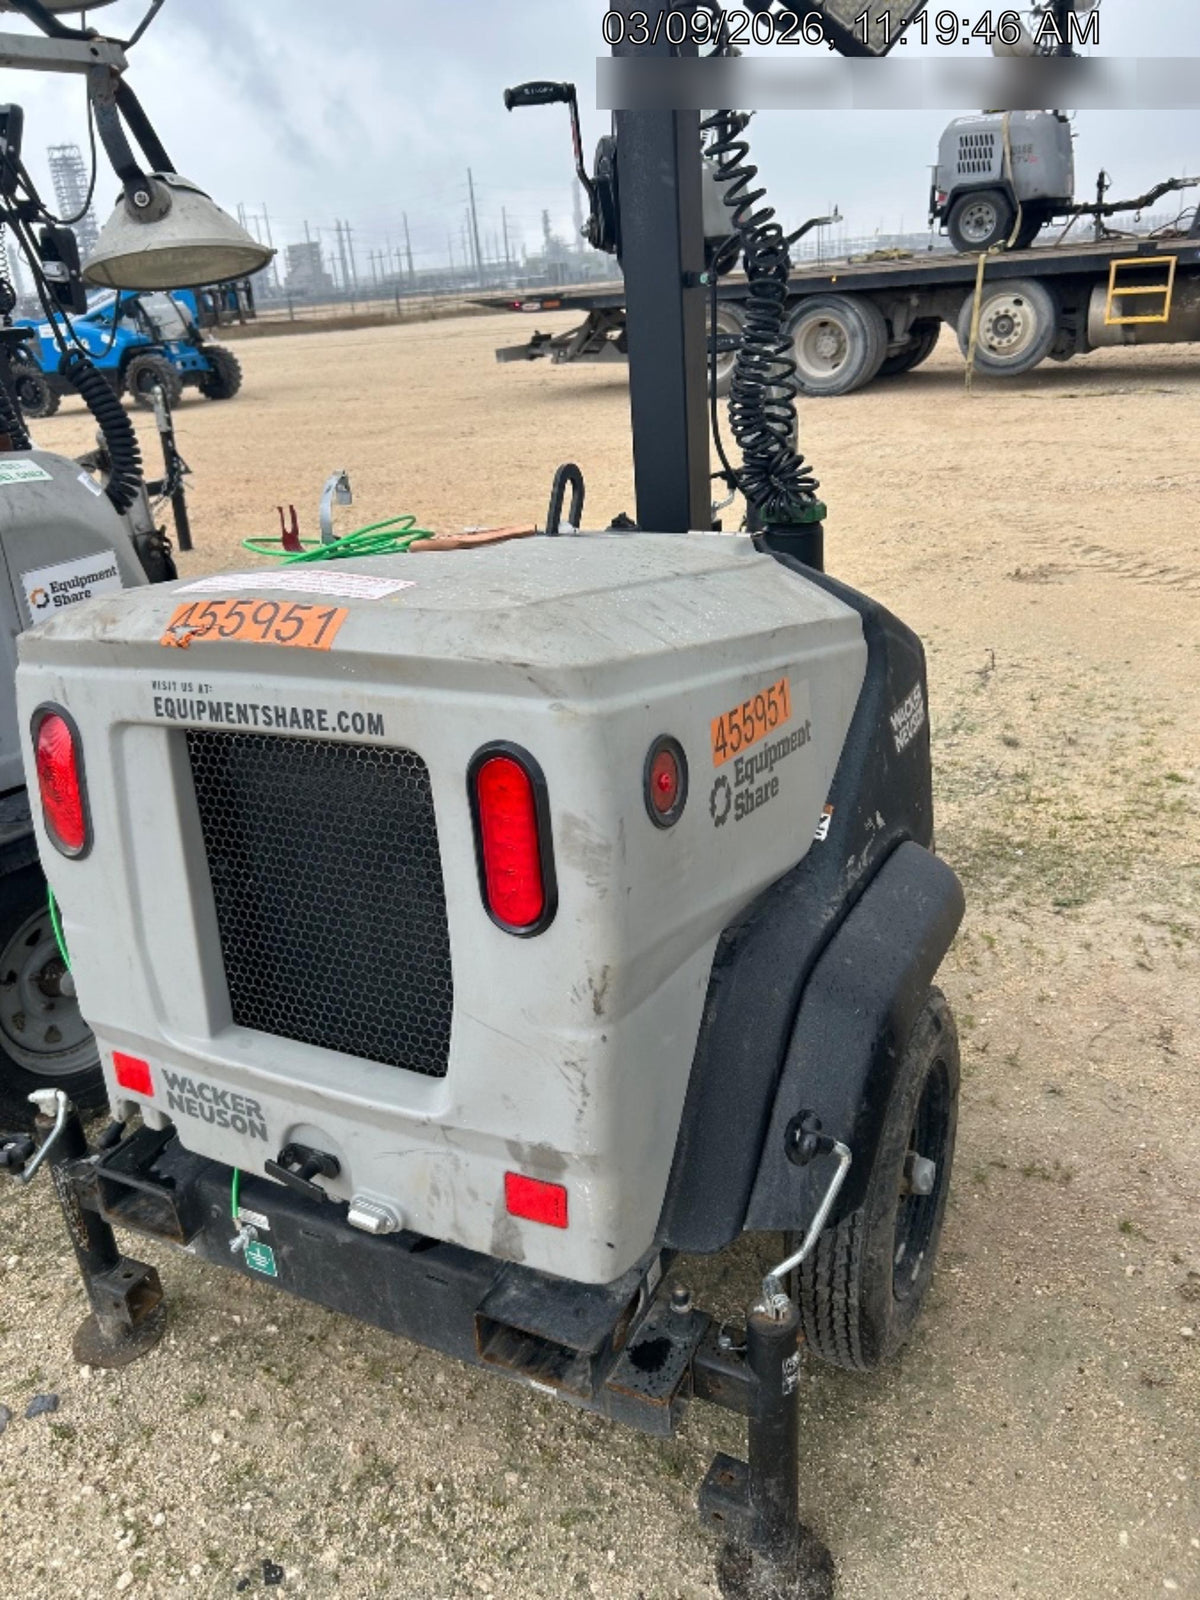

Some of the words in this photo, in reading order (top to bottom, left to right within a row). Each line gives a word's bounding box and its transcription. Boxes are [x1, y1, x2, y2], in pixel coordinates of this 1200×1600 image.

[49, 565, 117, 593] Equipment
[52, 590, 91, 607] Share
[167, 600, 338, 645] 455951
[151, 680, 177, 692] VISIT
[181, 682, 194, 693] US
[153, 696, 385, 736] EQUIPMENTSHARE.COM
[714, 679, 789, 759] 455951
[734, 719, 812, 788] Equipment
[734, 776, 780, 822] Share
[161, 1068, 265, 1121] WACKER
[167, 1090, 268, 1141] NEUSON
